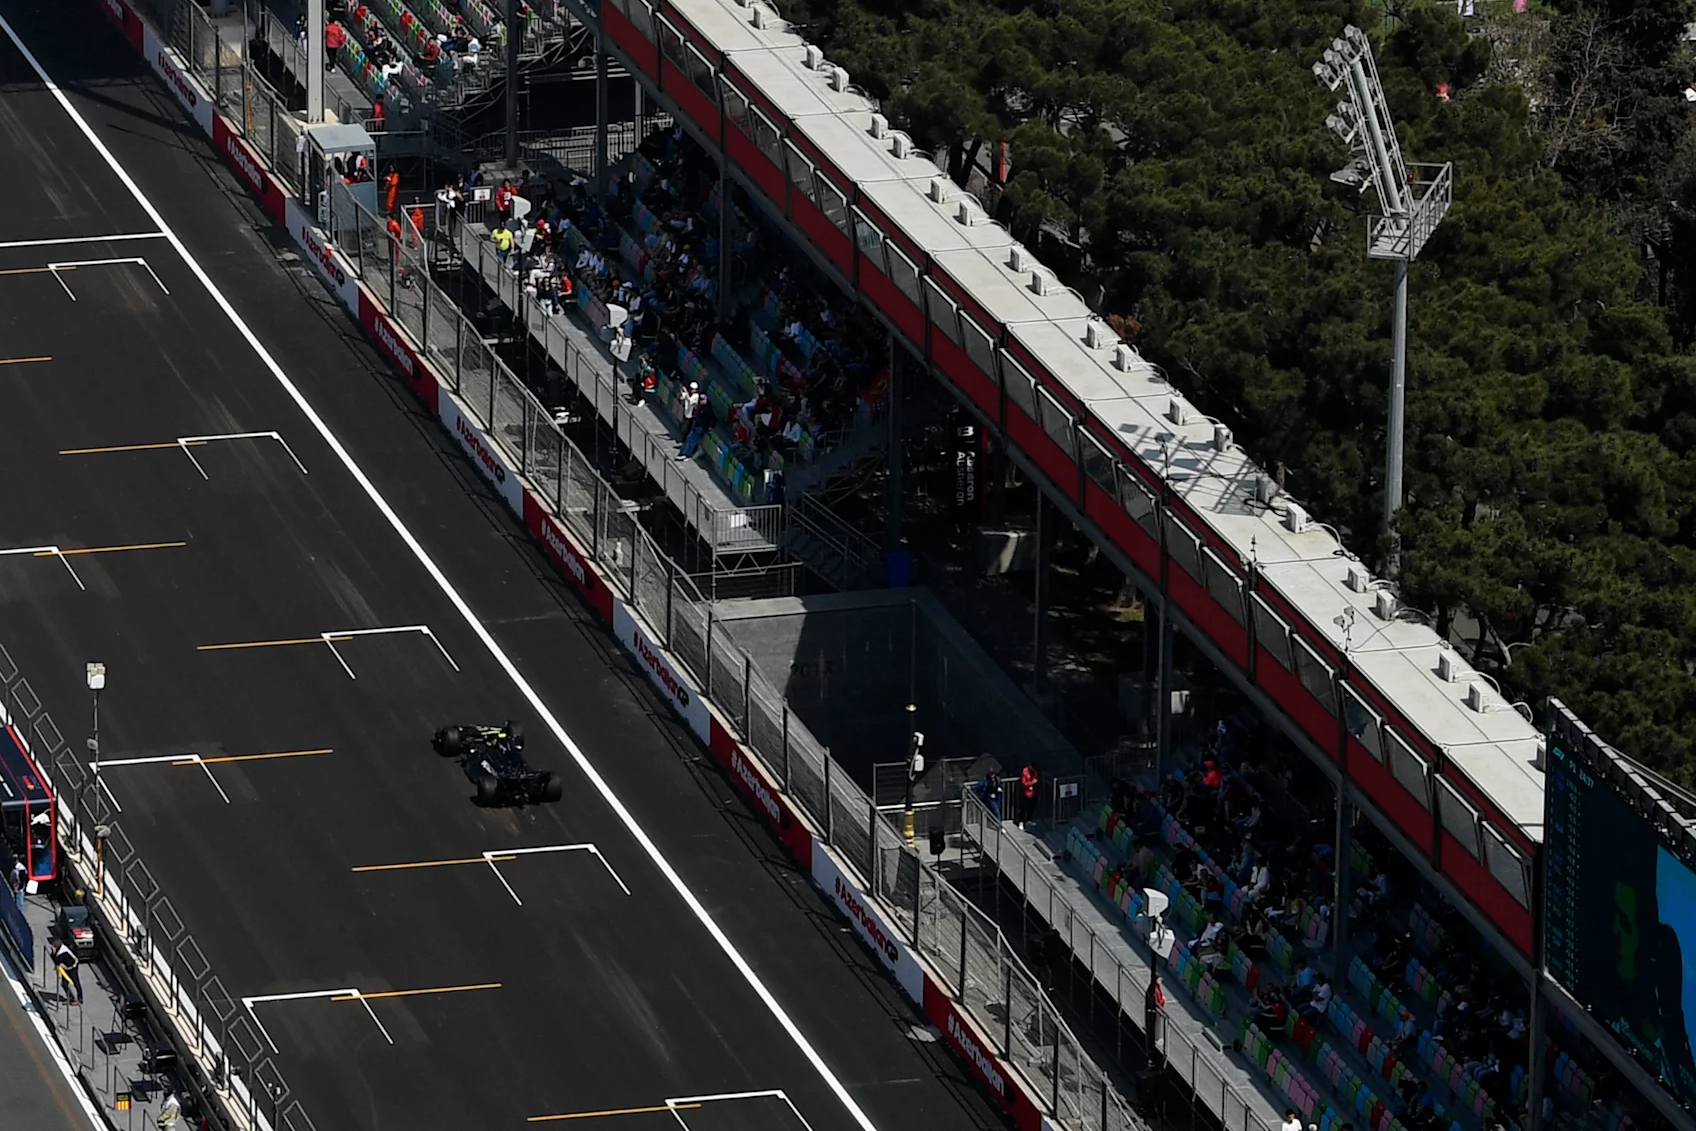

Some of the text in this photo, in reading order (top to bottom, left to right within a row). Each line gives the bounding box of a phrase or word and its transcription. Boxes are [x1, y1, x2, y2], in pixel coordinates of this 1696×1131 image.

[540, 518, 595, 592] #Azerbaijan
[632, 629, 690, 708] #AzerbaijanGP
[731, 749, 792, 830] #Azerbaijan
[835, 875, 899, 964] #AzerbaijanGP
[947, 1013, 1016, 1105] #Azerbaijan
